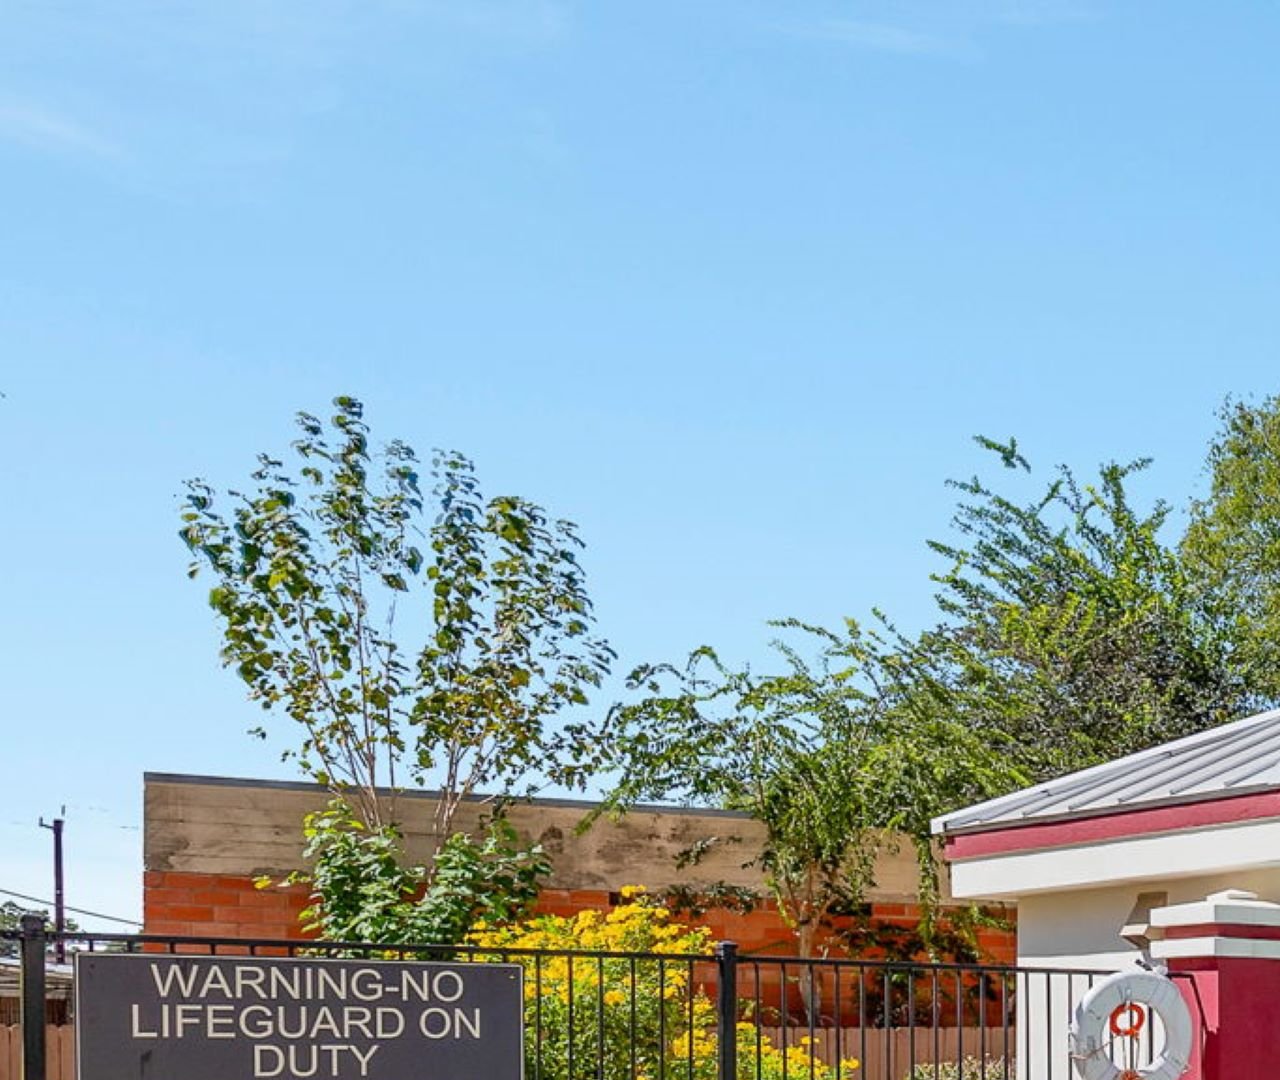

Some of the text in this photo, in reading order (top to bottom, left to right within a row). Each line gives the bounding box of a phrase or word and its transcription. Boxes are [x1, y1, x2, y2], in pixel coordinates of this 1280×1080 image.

[151, 964, 464, 1000] WARNING-NO
[131, 1004, 481, 1040] LIFEGUARD ON
[253, 1045, 380, 1078] DUTY
